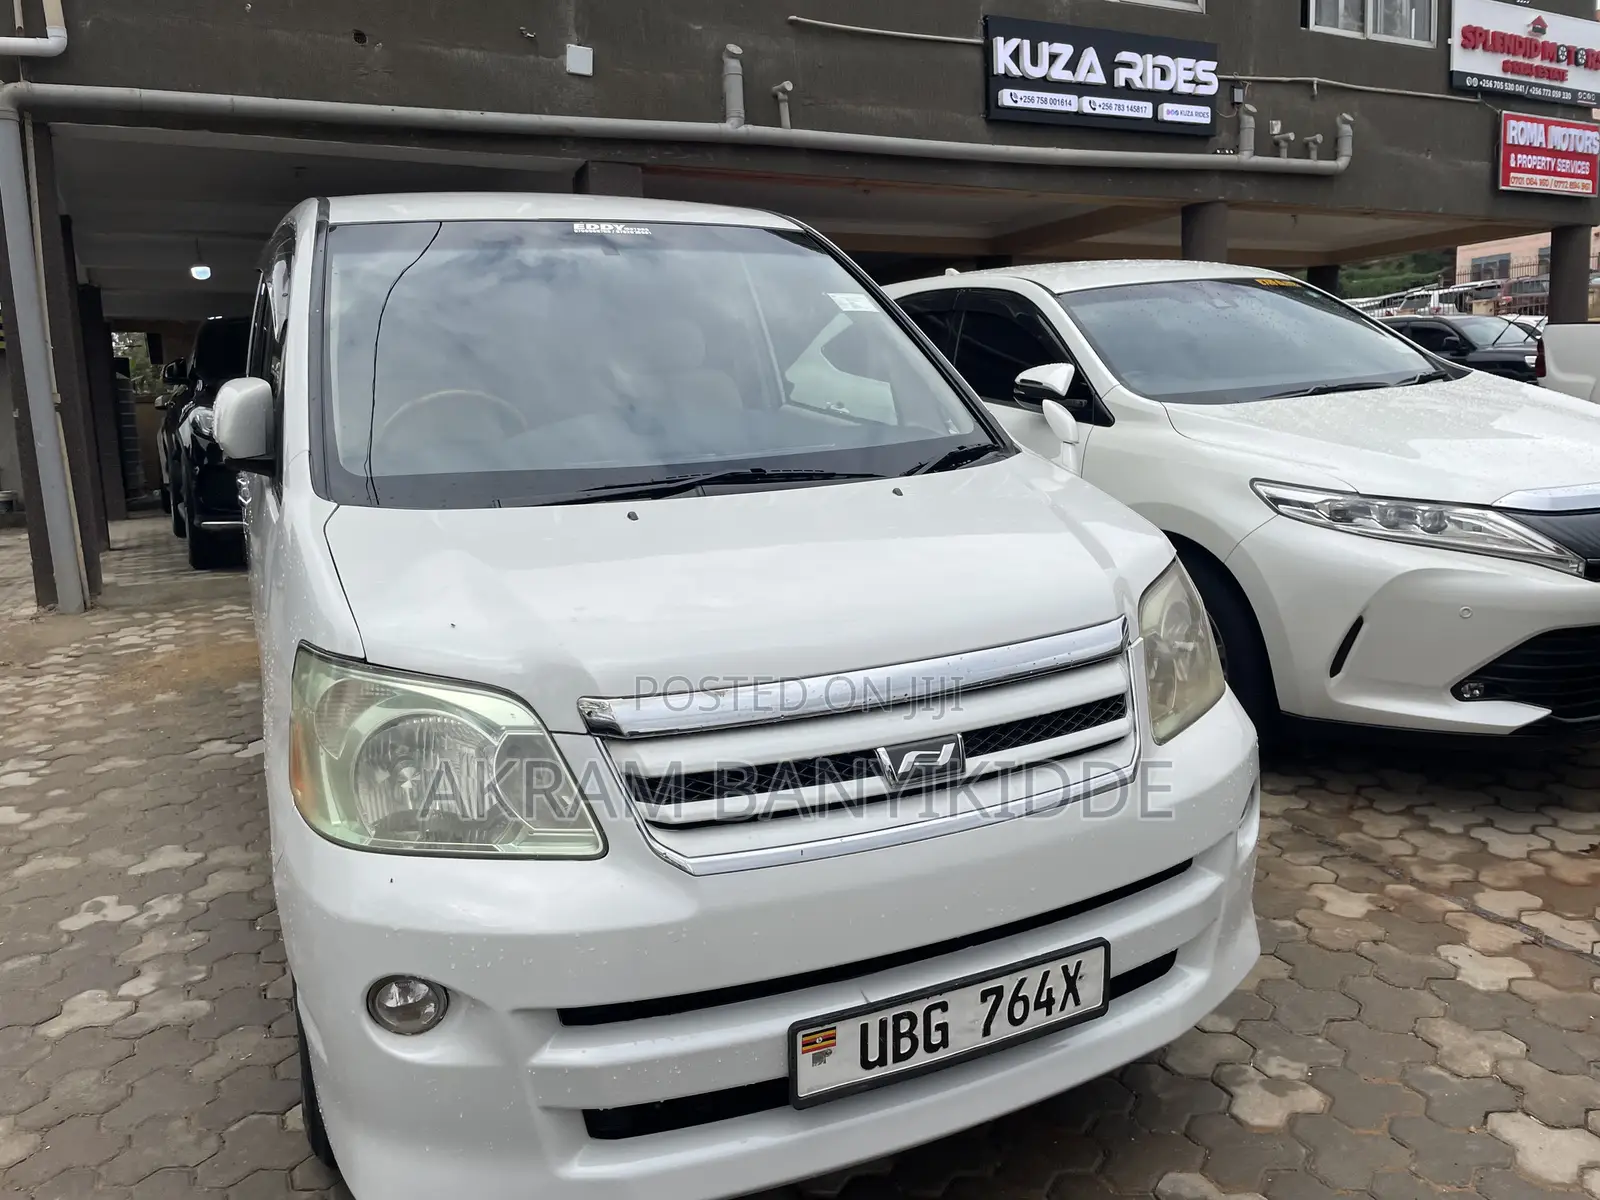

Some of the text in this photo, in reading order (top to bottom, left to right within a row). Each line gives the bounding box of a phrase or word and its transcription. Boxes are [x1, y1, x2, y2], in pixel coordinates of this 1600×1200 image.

[1461, 24, 1541, 59] SPLENDID
[993, 36, 1219, 96] KUZA RIDES
[1534, 64, 1568, 82] ESTATE
[1480, 79, 1493, 88] +256
[1019, 95, 1072, 107] +256 758 001614
[1098, 102, 1148, 113] +256 783 145817
[1180, 109, 1209, 119] KUZA RIDES
[1507, 120, 1599, 155] ROMA MOTORS
[1510, 153, 1590, 175] & PROPERTY SERVICES
[573, 222, 625, 231] EDDY
[859, 959, 1083, 1071] UBG 764X
